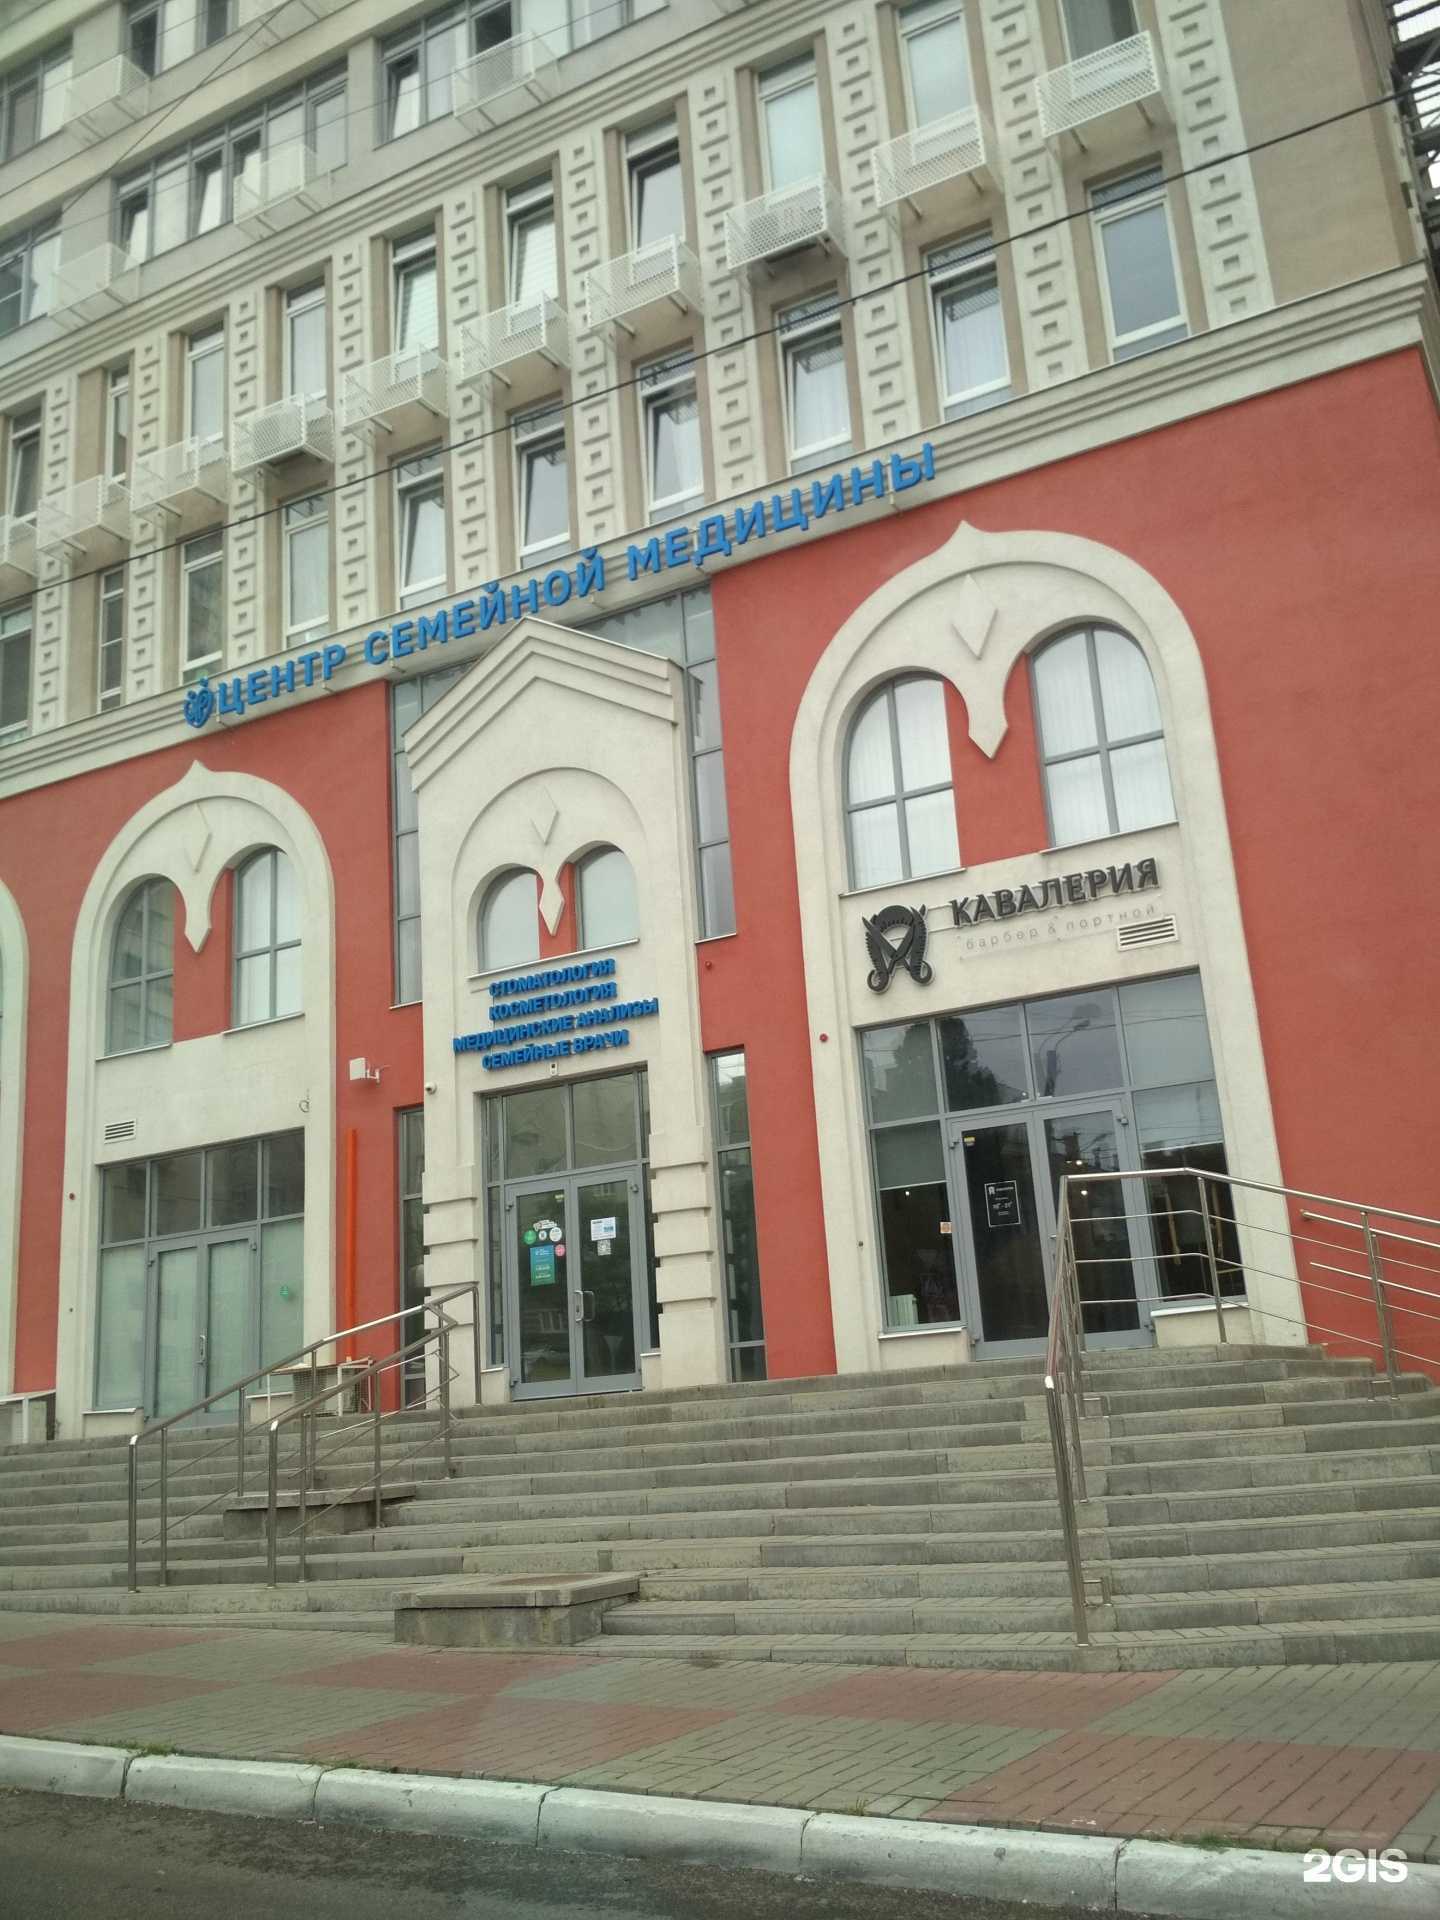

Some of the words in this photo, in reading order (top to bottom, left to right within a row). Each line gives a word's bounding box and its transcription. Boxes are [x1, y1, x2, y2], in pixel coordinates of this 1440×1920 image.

[218, 643, 347, 716] ЦЕНТР
[363, 546, 606, 666] СЕМЕЙНОЙ
[627, 442, 936, 581] МЕДИЦИНЫ
[950, 857, 1161, 927] КАВАЛЕРИЯ
[966, 927, 1039, 950] барбер
[1066, 904, 1156, 931] портной
[488, 958, 616, 998] СТОМАТОЛОГИЯ
[488, 981, 618, 1022] КОСМЕТОЛОГИЯ
[453, 1014, 574, 1055] МЕДИЦИНСКИЕ
[576, 997, 660, 1029] АНАЛИЗЫ
[481, 1038, 571, 1072] СЕМЕЙНЫЕ
[573, 1028, 630, 1055] ВРАЧИ
